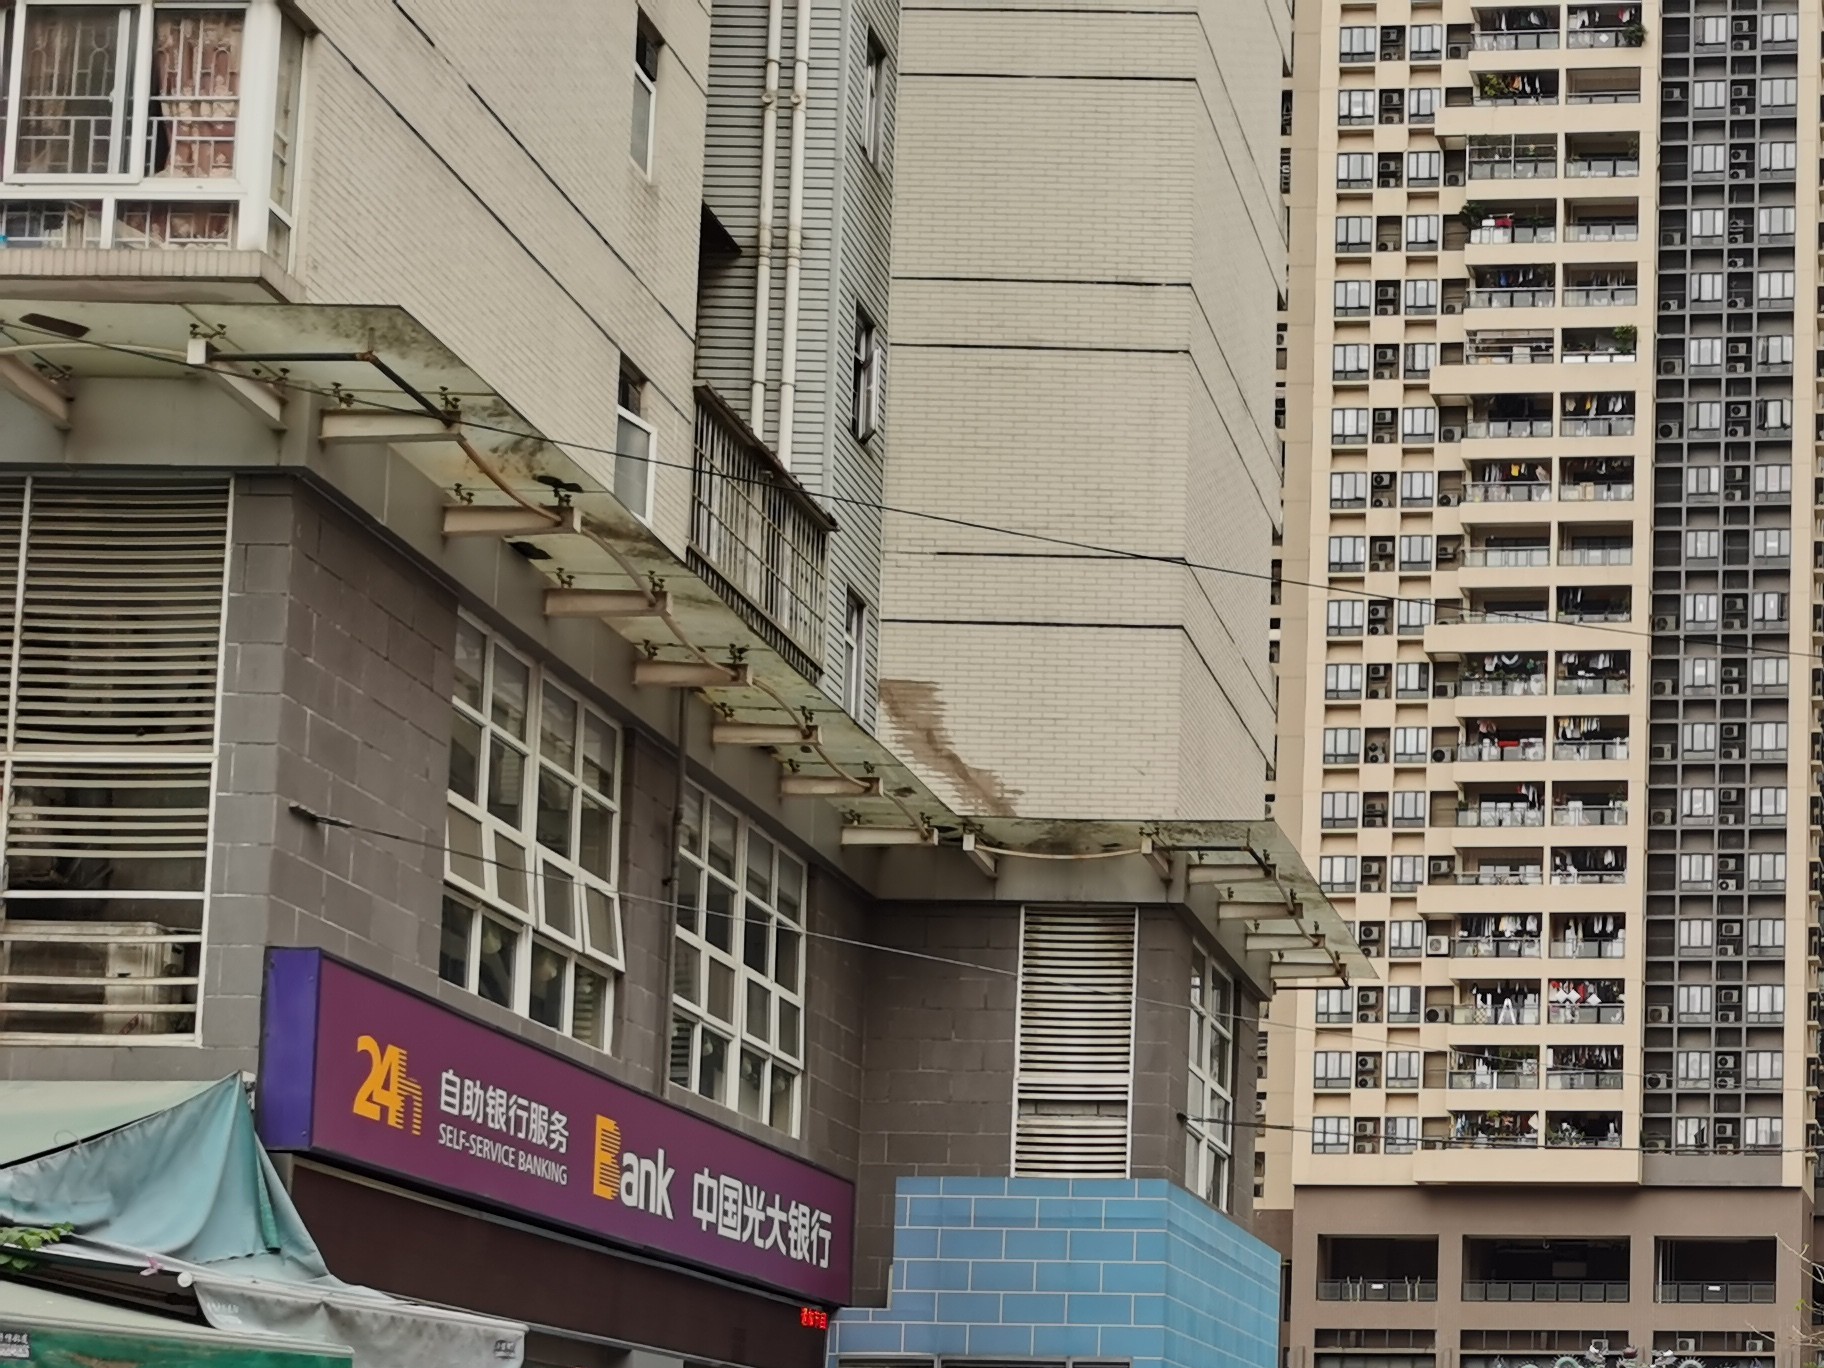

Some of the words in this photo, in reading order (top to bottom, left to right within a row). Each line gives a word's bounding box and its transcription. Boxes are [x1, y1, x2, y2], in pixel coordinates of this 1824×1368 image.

[438, 1123, 516, 1168] SELF-SERVICE
[518, 1150, 568, 1186] BANKING
[440, 1068, 570, 1154] 自助银行服务
[593, 1113, 675, 1220] Bank
[692, 1167, 832, 1269] 中国光大银行
